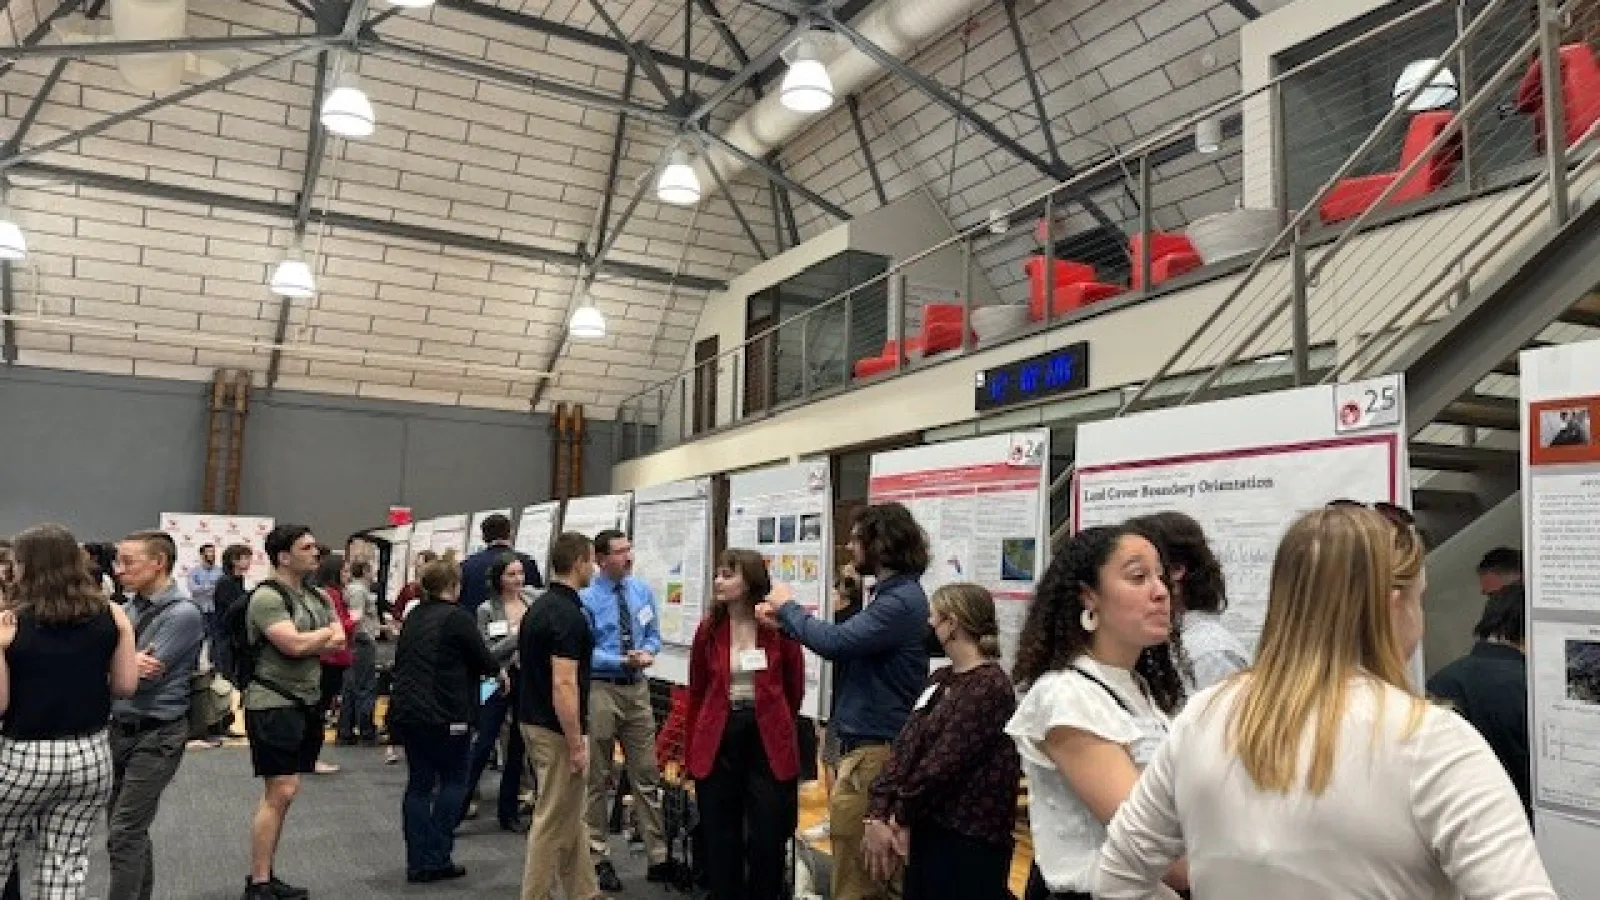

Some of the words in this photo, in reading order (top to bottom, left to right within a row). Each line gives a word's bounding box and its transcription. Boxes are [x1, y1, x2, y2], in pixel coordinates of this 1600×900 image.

[1364, 384, 1396, 413] 25
[1025, 440, 1043, 459] 24
[1107, 486, 1138, 500] Cover
[1141, 482, 1196, 498] Boundary
[1198, 476, 1275, 493] Orientation
